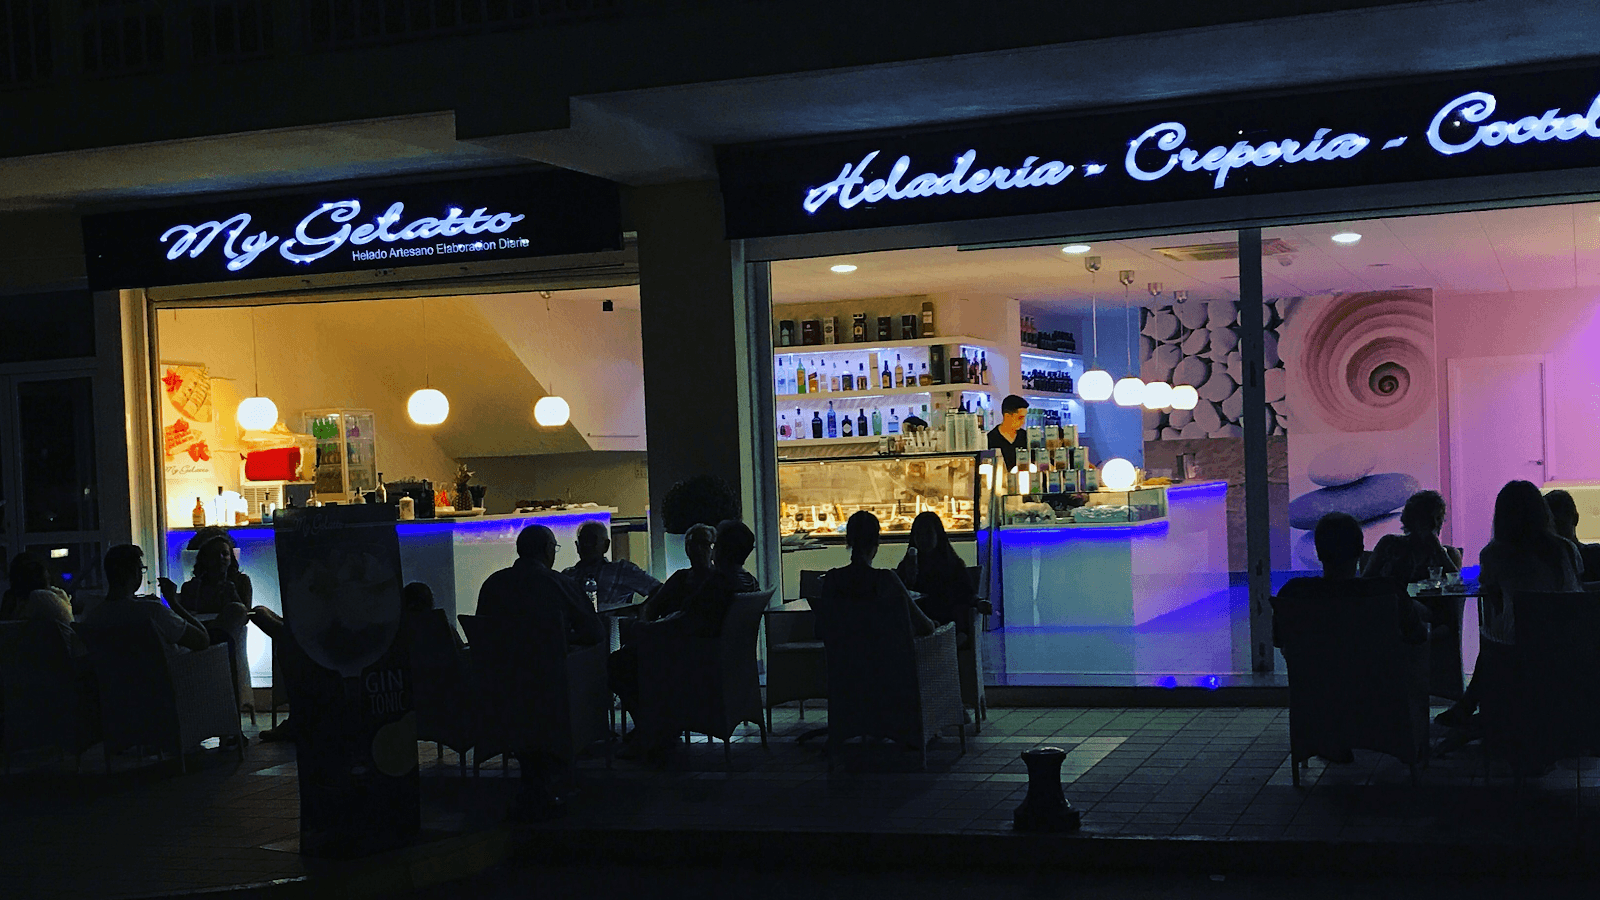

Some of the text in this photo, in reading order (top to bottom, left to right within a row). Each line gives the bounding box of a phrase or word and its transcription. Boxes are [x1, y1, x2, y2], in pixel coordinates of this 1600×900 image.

[159, 199, 525, 272] My Gelatto
[352, 249, 388, 262] Helado
[389, 245, 434, 259] Artesano
[365, 668, 404, 694] GIN
[369, 690, 407, 715] TONIC
